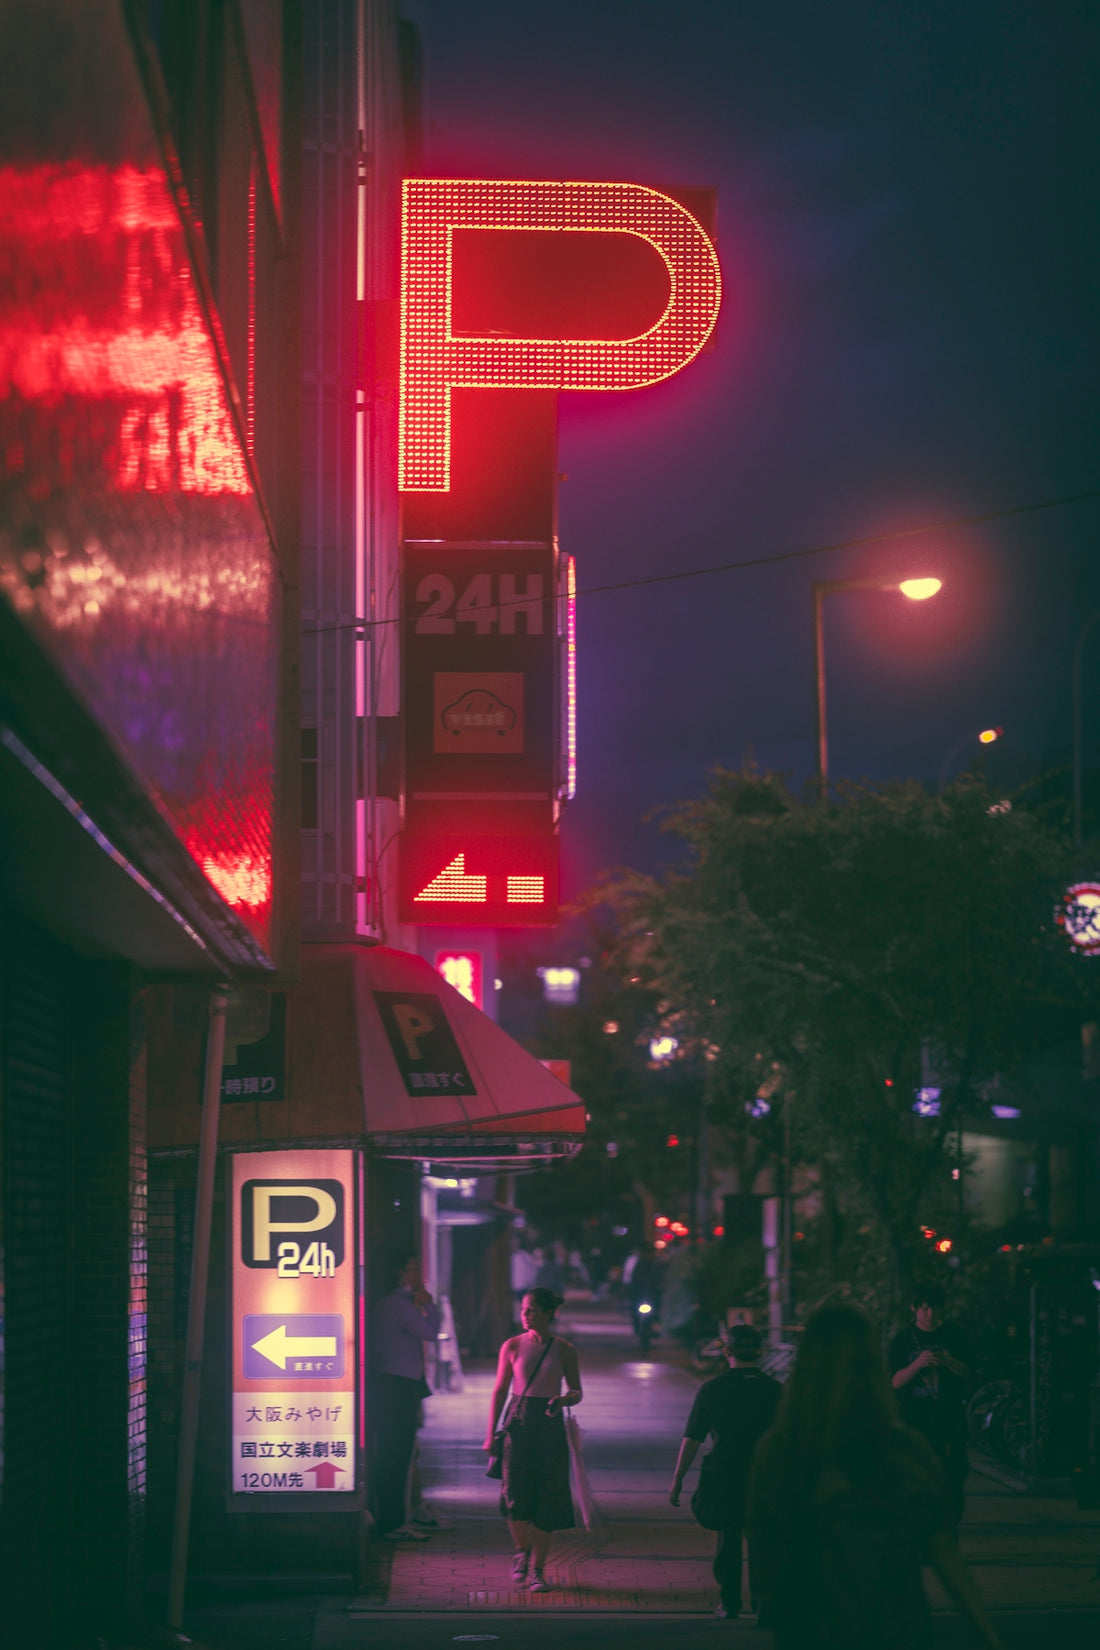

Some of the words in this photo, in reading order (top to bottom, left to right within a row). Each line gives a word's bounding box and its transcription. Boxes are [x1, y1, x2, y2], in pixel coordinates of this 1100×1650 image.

[398, 179, 722, 492] P
[415, 573, 545, 634] 24H
[392, 1003, 435, 1061] P
[253, 1186, 337, 1261] P
[278, 1242, 336, 1278] 24h
[246, 1406, 343, 1422] 大阪みやげ
[241, 1441, 347, 1458] 国立文楽劇場
[240, 1472, 304, 1488] 120M先
